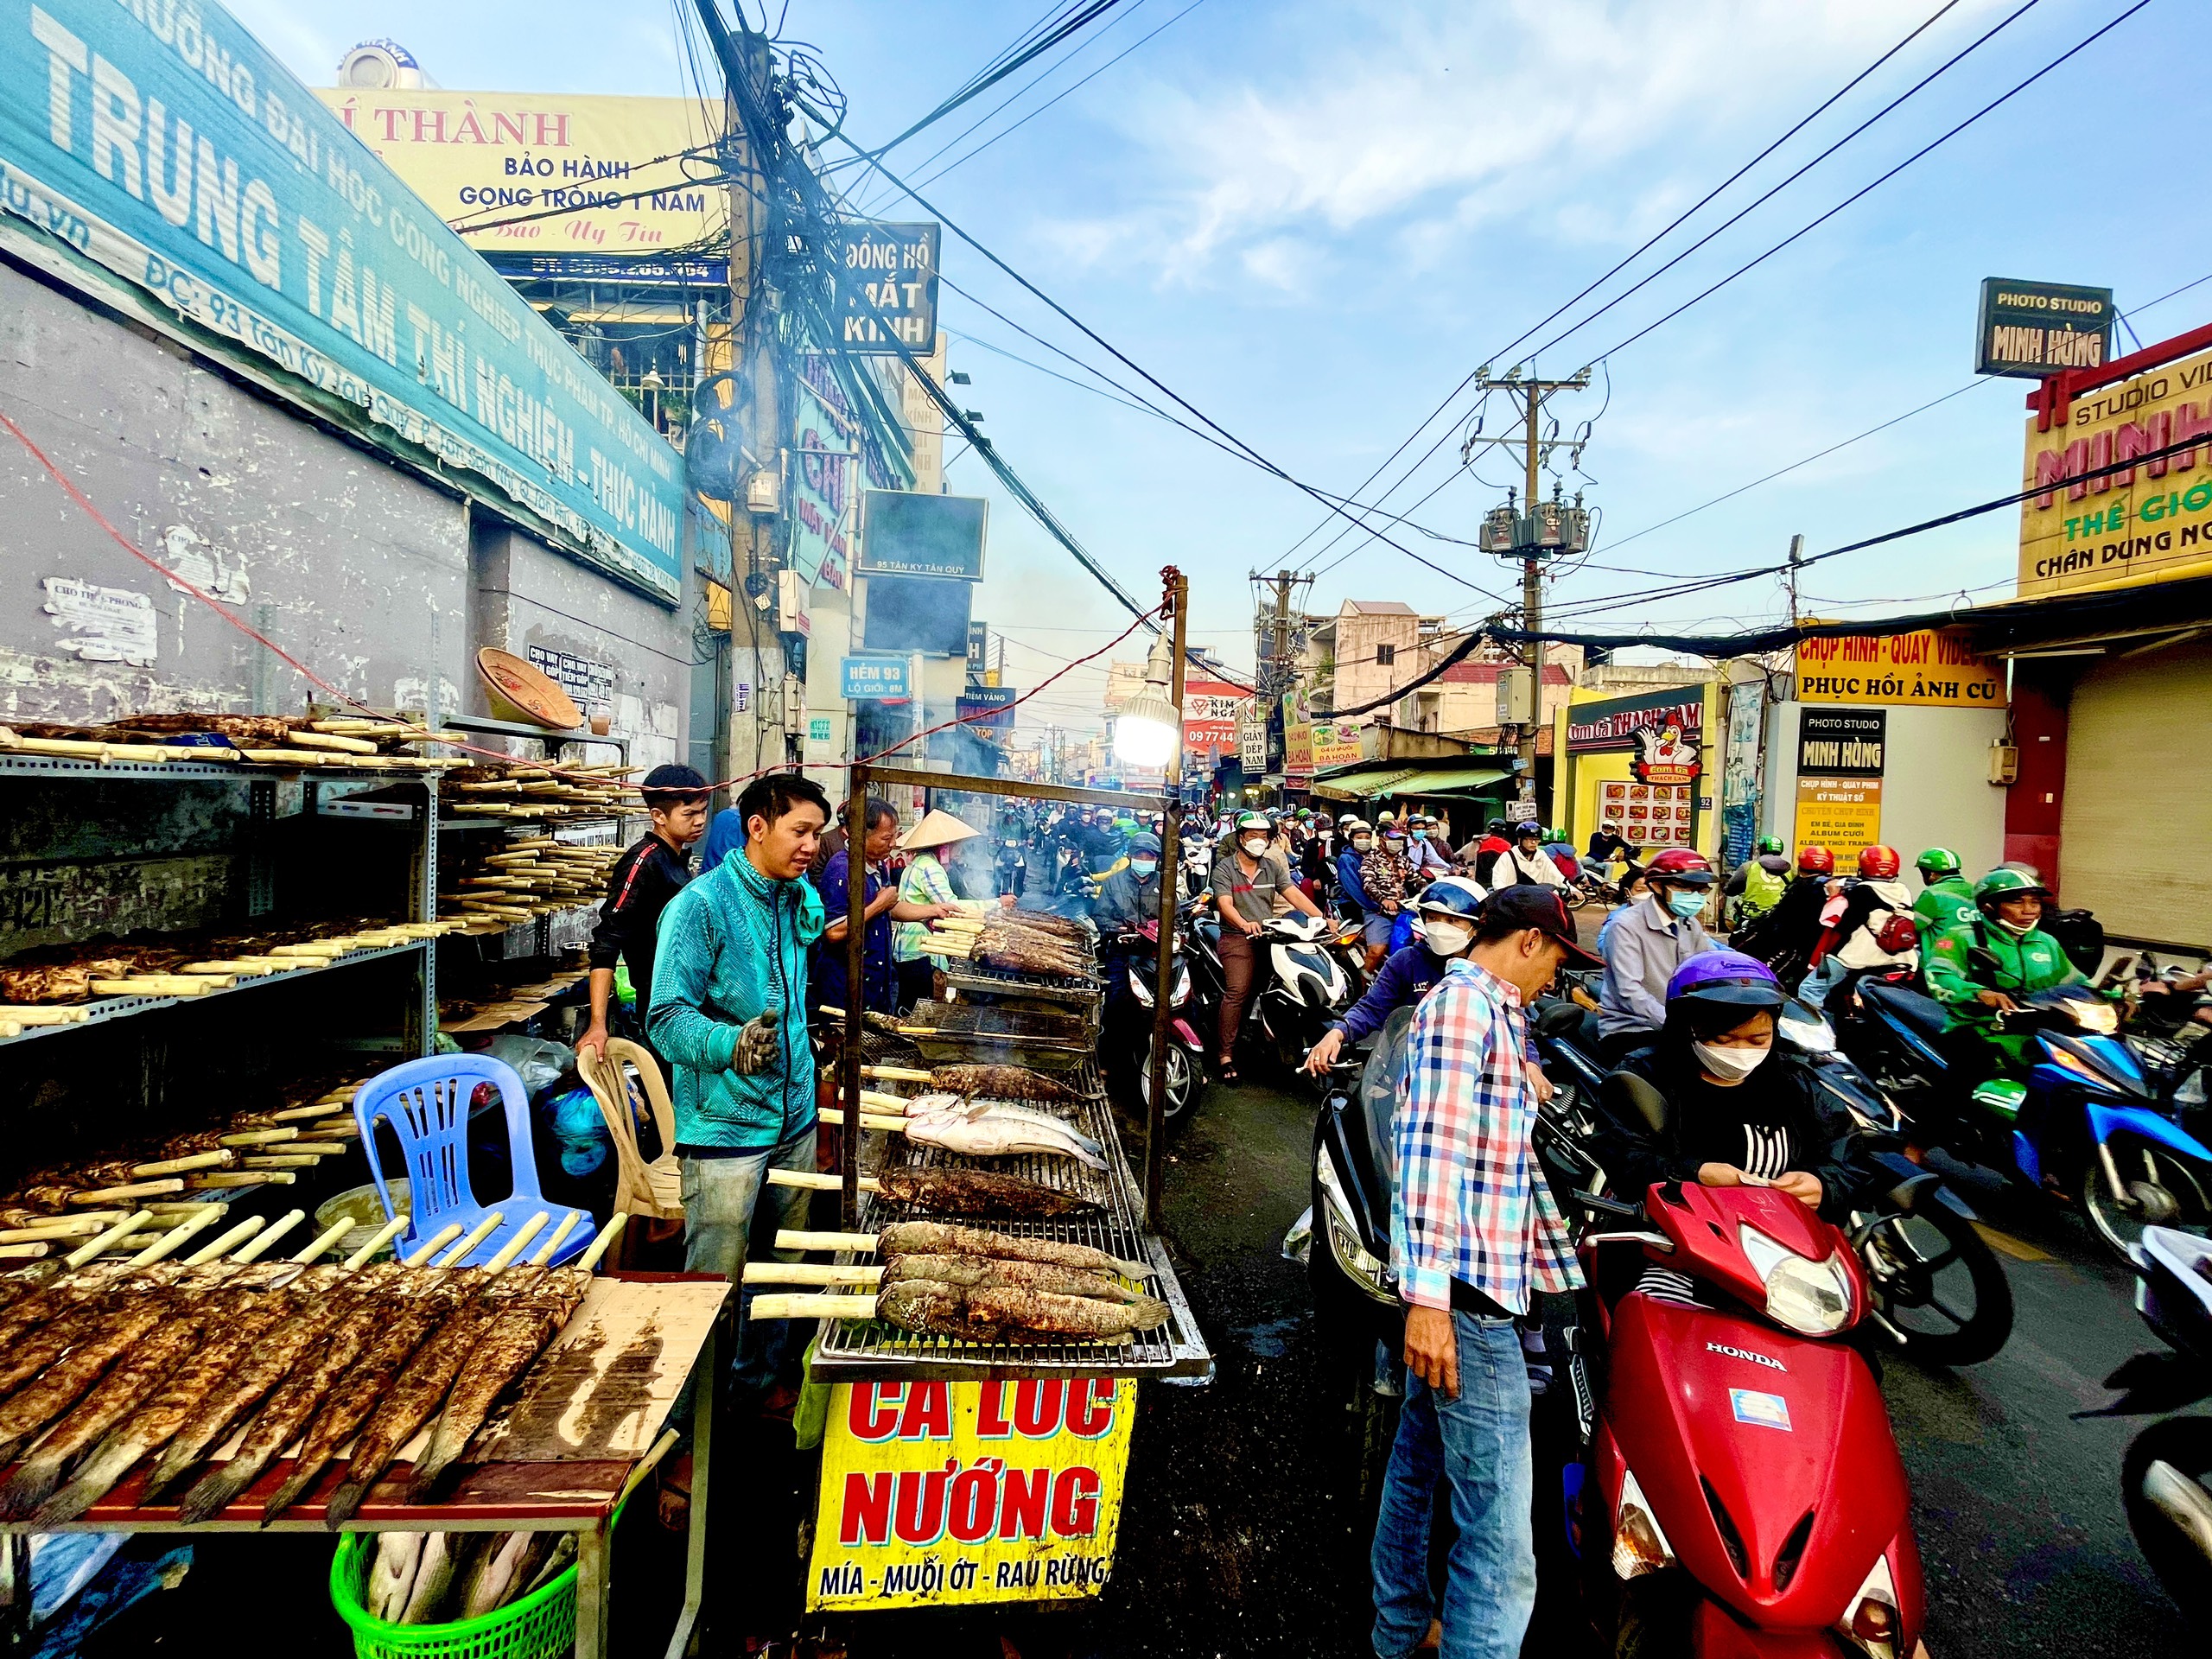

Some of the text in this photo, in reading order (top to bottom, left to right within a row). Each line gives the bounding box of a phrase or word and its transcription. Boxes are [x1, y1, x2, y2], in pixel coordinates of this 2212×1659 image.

[374, 99, 575, 147] THÀNH
[505, 151, 630, 180] BẢO HÀNH
[327, 145, 382, 227] HỌC
[459, 186, 533, 211] GỌNG
[903, 232, 930, 270] HỒ
[31, 3, 282, 292] TRUNG
[299, 214, 396, 368] TÂM
[407, 300, 467, 414] THÍ
[476, 354, 575, 487] NGHIỆM
[590, 446, 635, 533] THỰC
[639, 483, 676, 560] HÀNH
[210, 293, 242, 335] 93
[1997, 292, 2102, 314] PHOTO STUDIO
[1993, 325, 2043, 363] MINH
[2075, 378, 2169, 426] STUDIO
[2064, 493, 2127, 542] THẾ
[876, 560, 887, 569] 95
[889, 560, 908, 570] TÂN
[925, 563, 943, 574] TÂN
[2035, 548, 2094, 578] CHÂN
[2101, 530, 2172, 564] DUNG
[54, 585, 78, 596] CHO
[530, 647, 559, 664] CHO VAY
[1891, 633, 1931, 665] QUAY
[563, 658, 575, 670] CHO
[849, 662, 900, 681] HẺM 93
[983, 690, 1007, 702] VÀNG
[1802, 671, 1997, 700] PHỤC HỒI ẢNH CŨ
[1211, 699, 1235, 709] KIM
[1243, 729, 1263, 741] GIÀY
[1808, 718, 1879, 729] PHOTO STUDIO
[1245, 755, 1264, 766] NAM
[1246, 743, 1262, 753] DÉP
[1802, 740, 1840, 767] MINH
[1801, 779, 1820, 790] CHỤP
[1821, 779, 1838, 788] HÌNH
[1861, 781, 1879, 790] PHIM
[1700, 798, 1711, 806] 92
[1706, 1342, 1788, 1372] HONDA
[839, 1457, 1104, 1548] NƯỚNG
[820, 1560, 863, 1596] MÍA
[995, 1560, 1039, 1589] RAU
